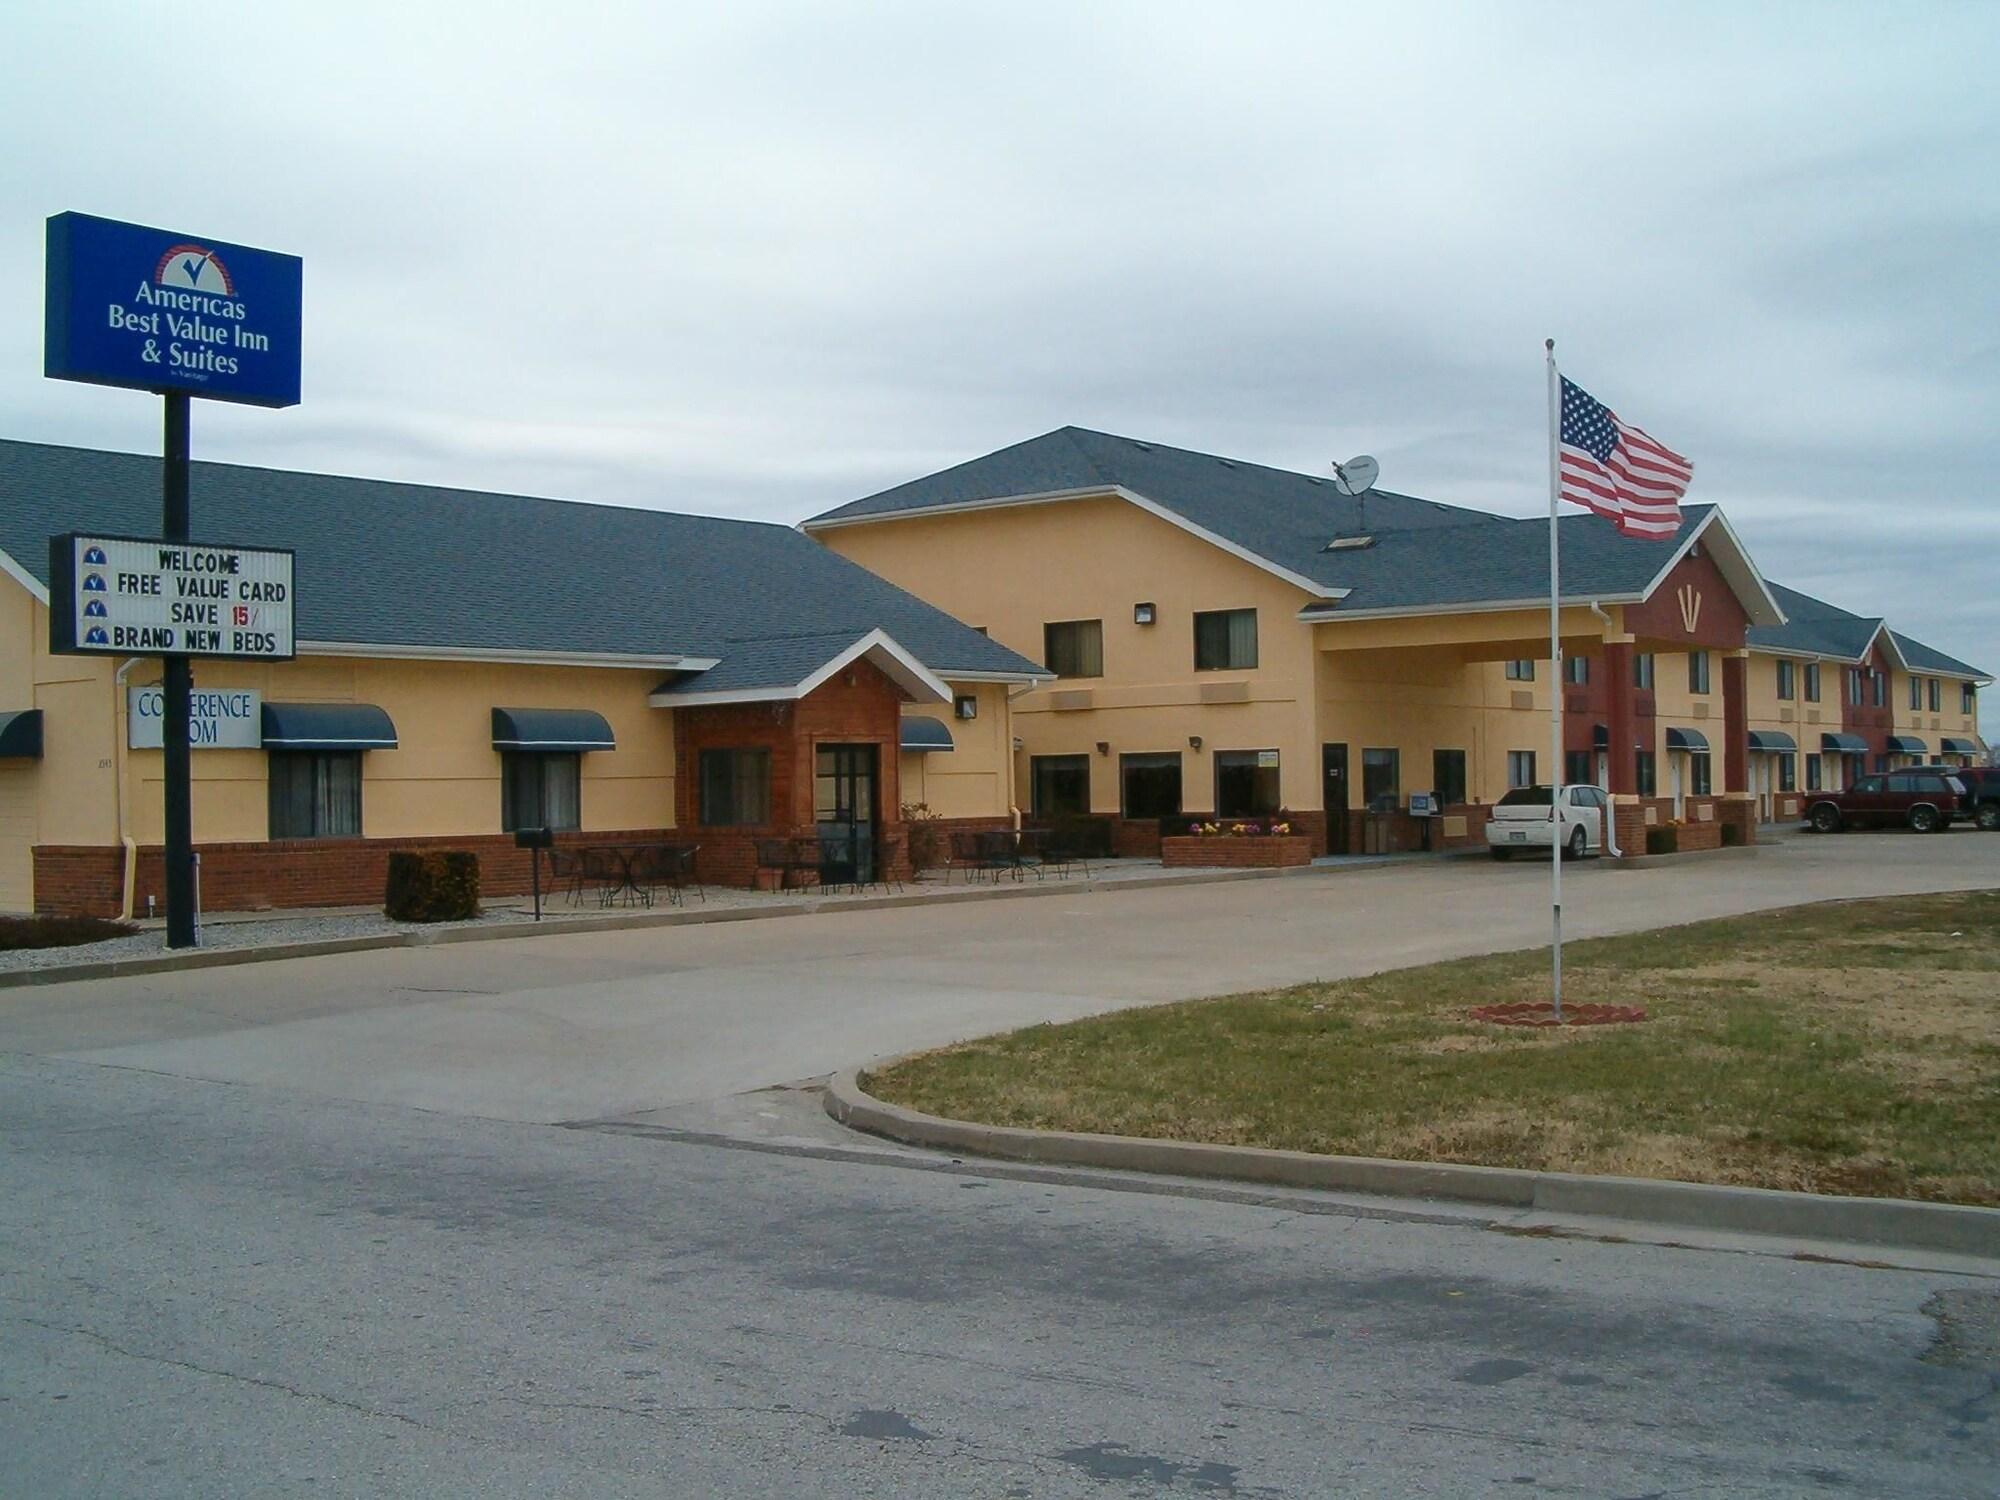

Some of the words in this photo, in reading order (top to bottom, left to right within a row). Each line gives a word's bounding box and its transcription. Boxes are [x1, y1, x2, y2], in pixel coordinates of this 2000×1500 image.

[135, 280, 246, 320] Americas
[108, 304, 160, 335] Best
[166, 312, 229, 345] Value
[234, 324, 269, 351] Inn
[141, 338, 162, 364] &
[169, 342, 238, 375] Suites
[159, 550, 239, 575] WELCOME
[118, 573, 161, 596] FREE
[177, 577, 229, 599] VALUE
[239, 581, 286, 603] CARD
[171, 602, 218, 625] SAVE
[114, 626, 174, 649] BRAND
[186, 630, 221, 651] NEW
[233, 632, 276, 653] BEDS
[139, 693, 251, 718] COERENCE
